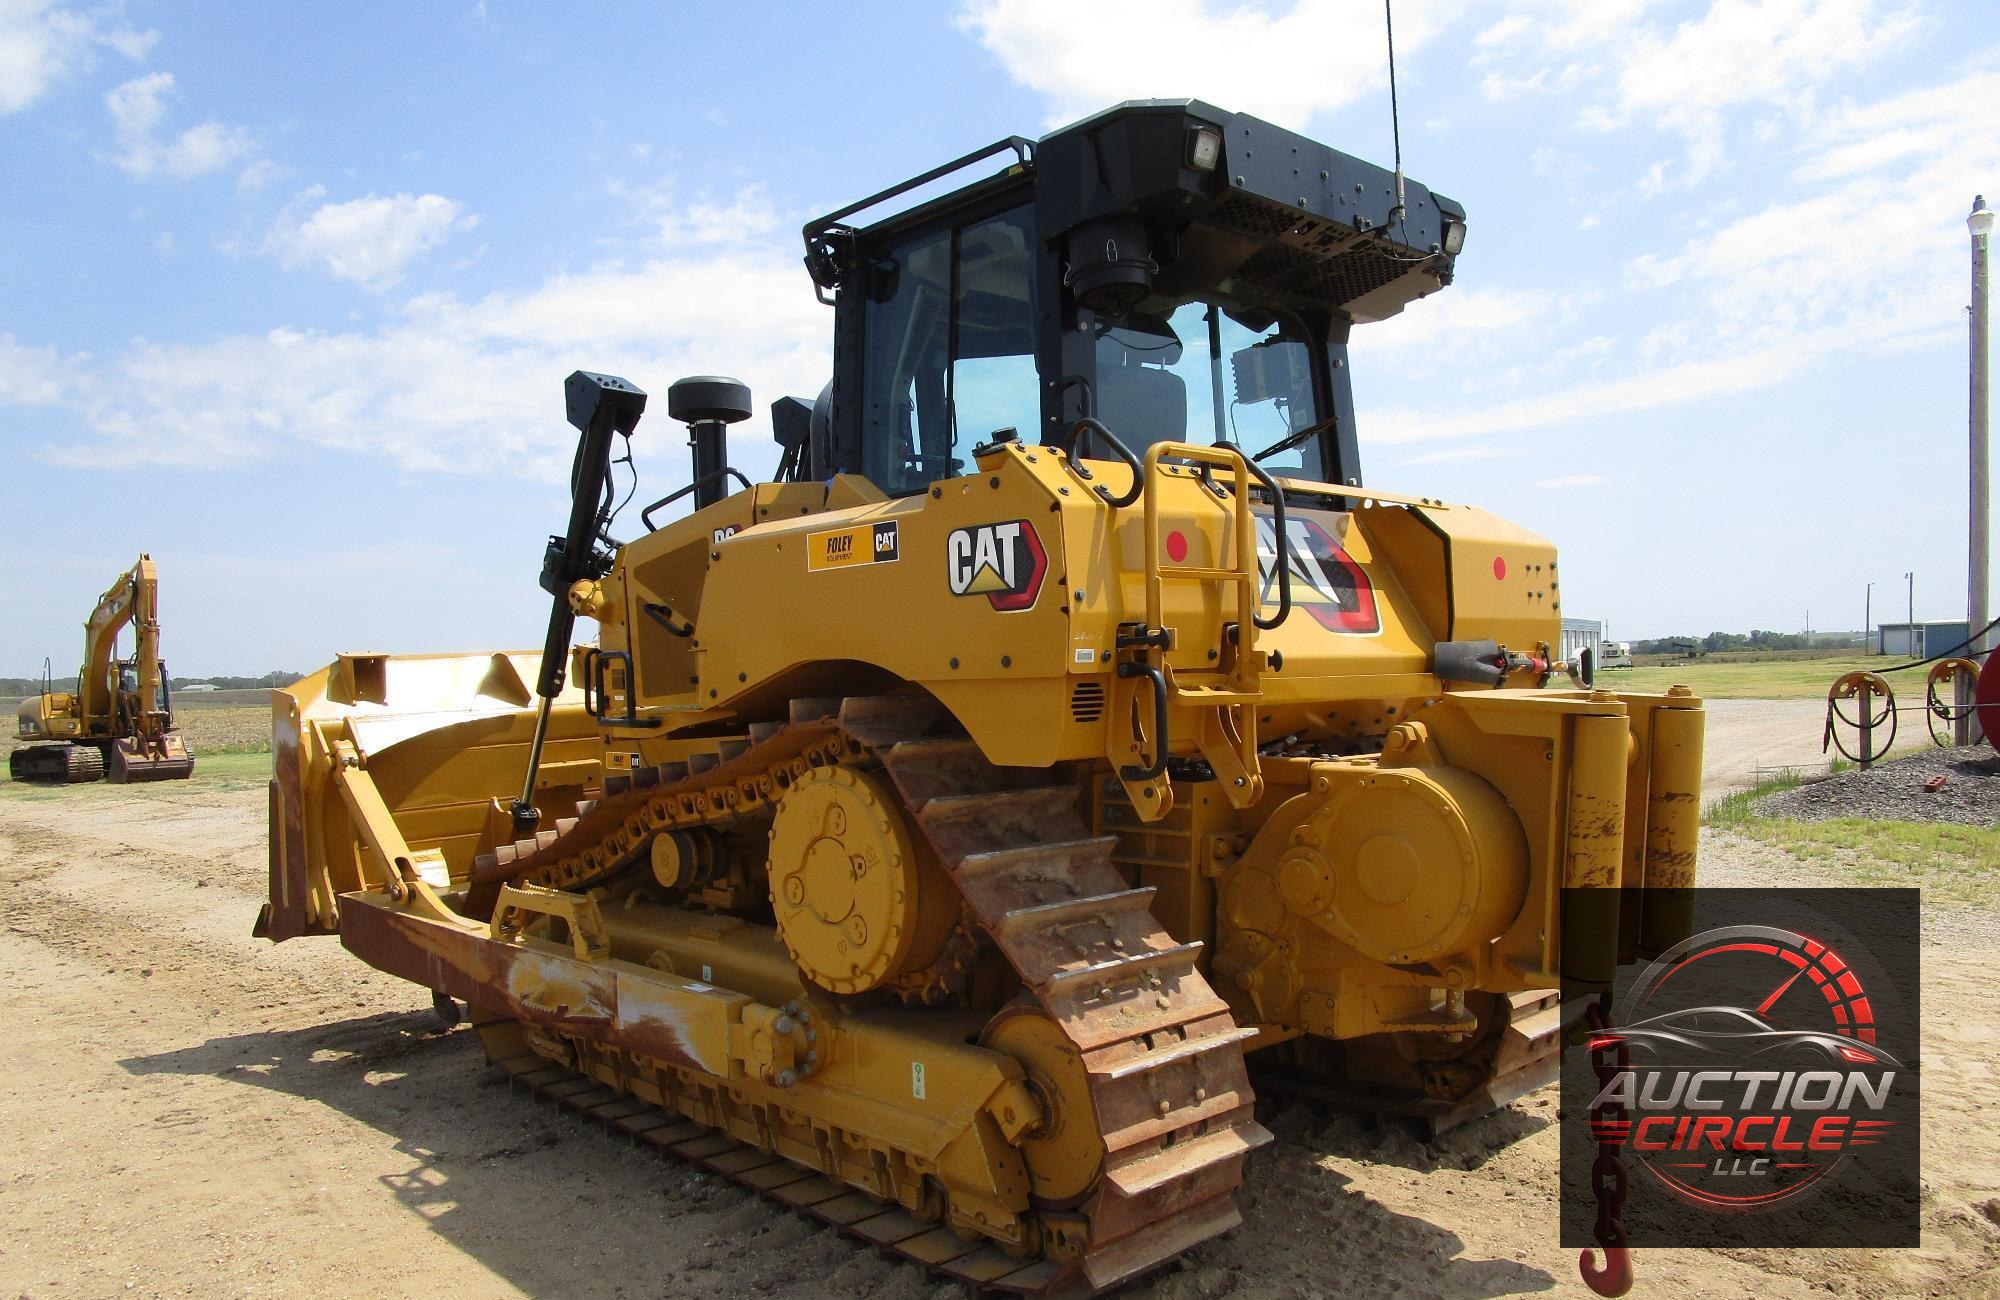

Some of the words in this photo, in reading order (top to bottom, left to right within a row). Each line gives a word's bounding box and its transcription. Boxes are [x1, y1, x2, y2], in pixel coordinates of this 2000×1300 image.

[827, 535, 853, 554] FOLEY
[875, 531, 895, 552] CAT
[948, 522, 1020, 594] CAT
[1255, 516, 1341, 604] AT
